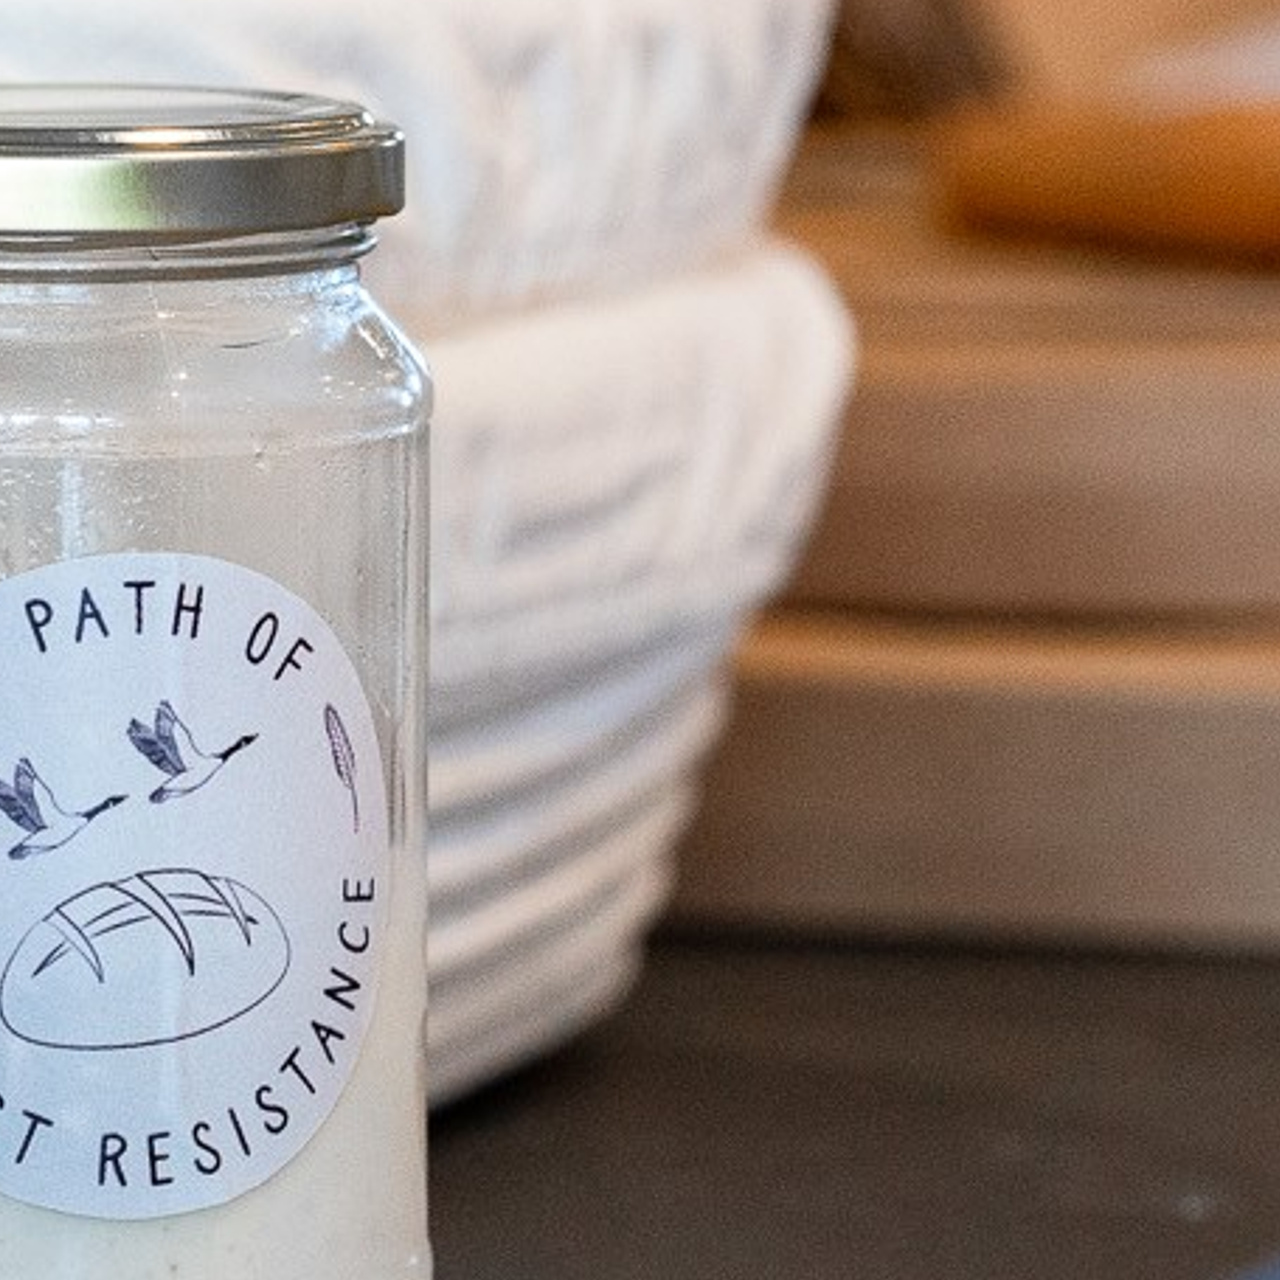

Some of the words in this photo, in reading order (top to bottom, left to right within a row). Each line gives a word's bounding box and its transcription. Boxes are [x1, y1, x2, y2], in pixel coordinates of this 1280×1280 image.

[24, 580, 205, 653] PATH
[245, 611, 315, 681] OF
[98, 876, 375, 1187] RESISTANCE
